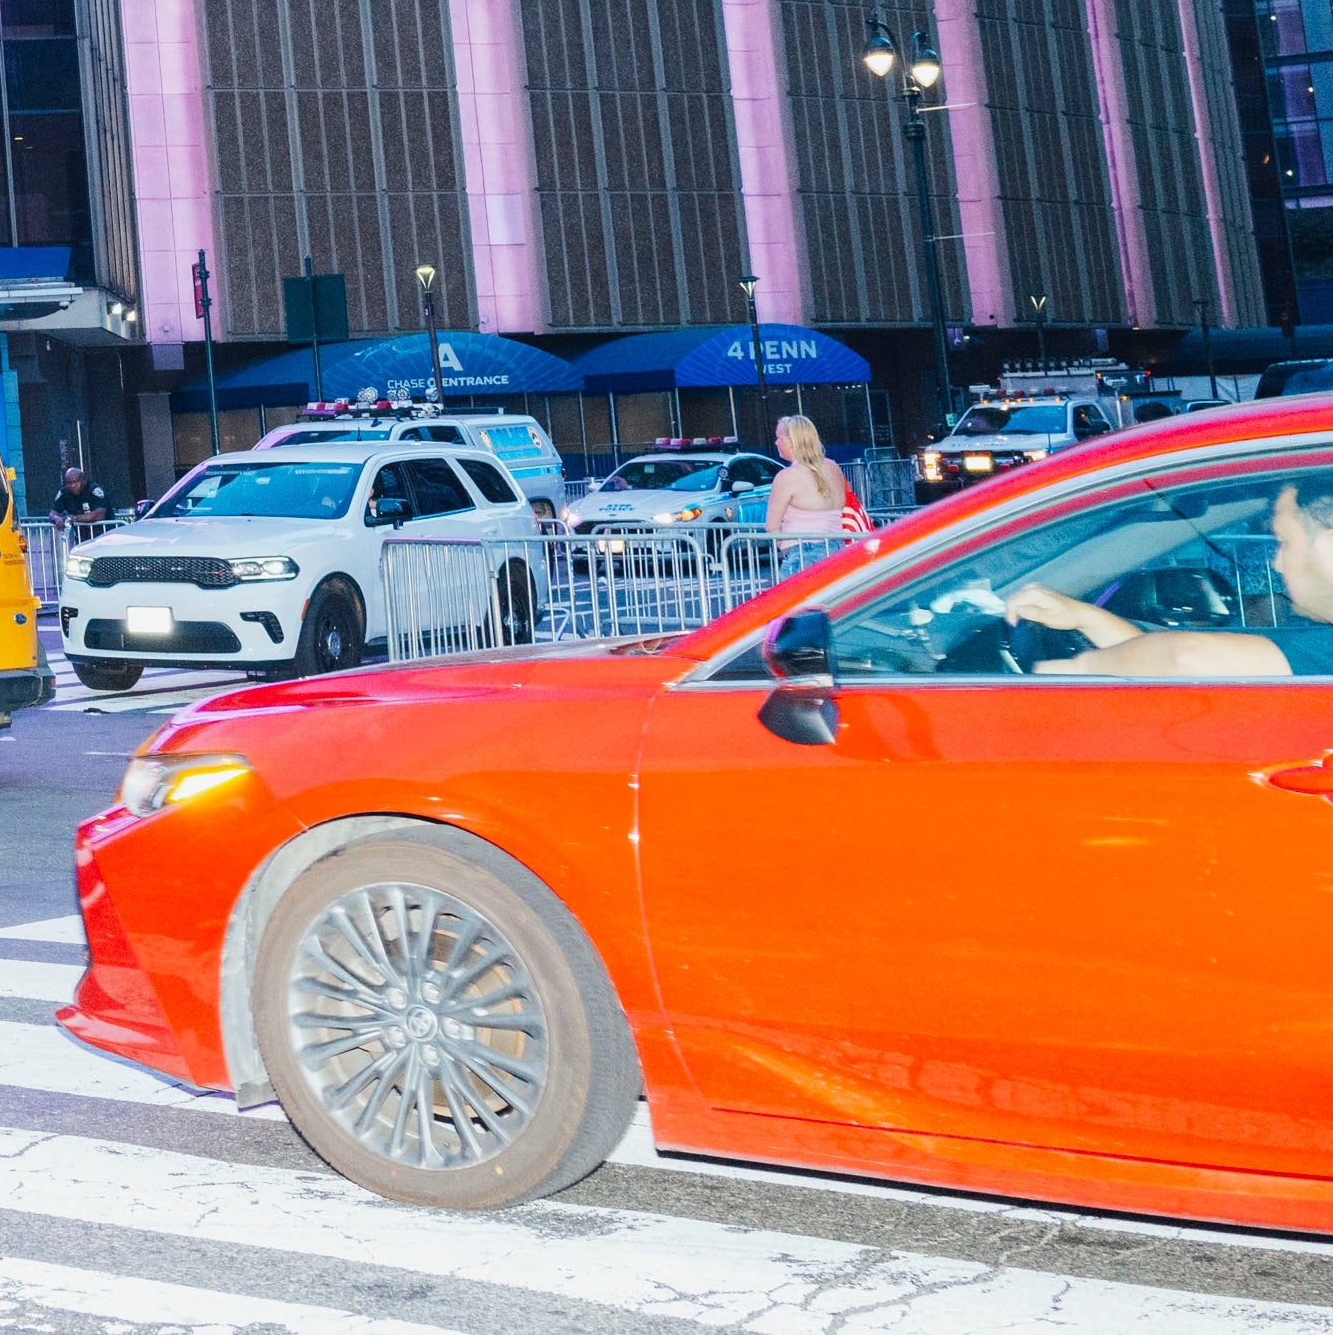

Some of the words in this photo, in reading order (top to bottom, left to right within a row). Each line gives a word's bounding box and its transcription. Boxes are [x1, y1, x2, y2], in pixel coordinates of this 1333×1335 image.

[431, 342, 464, 372] A
[726, 340, 745, 360] 4
[387, 377, 426, 390] CHASE
[441, 374, 510, 387] ENTRANCE
